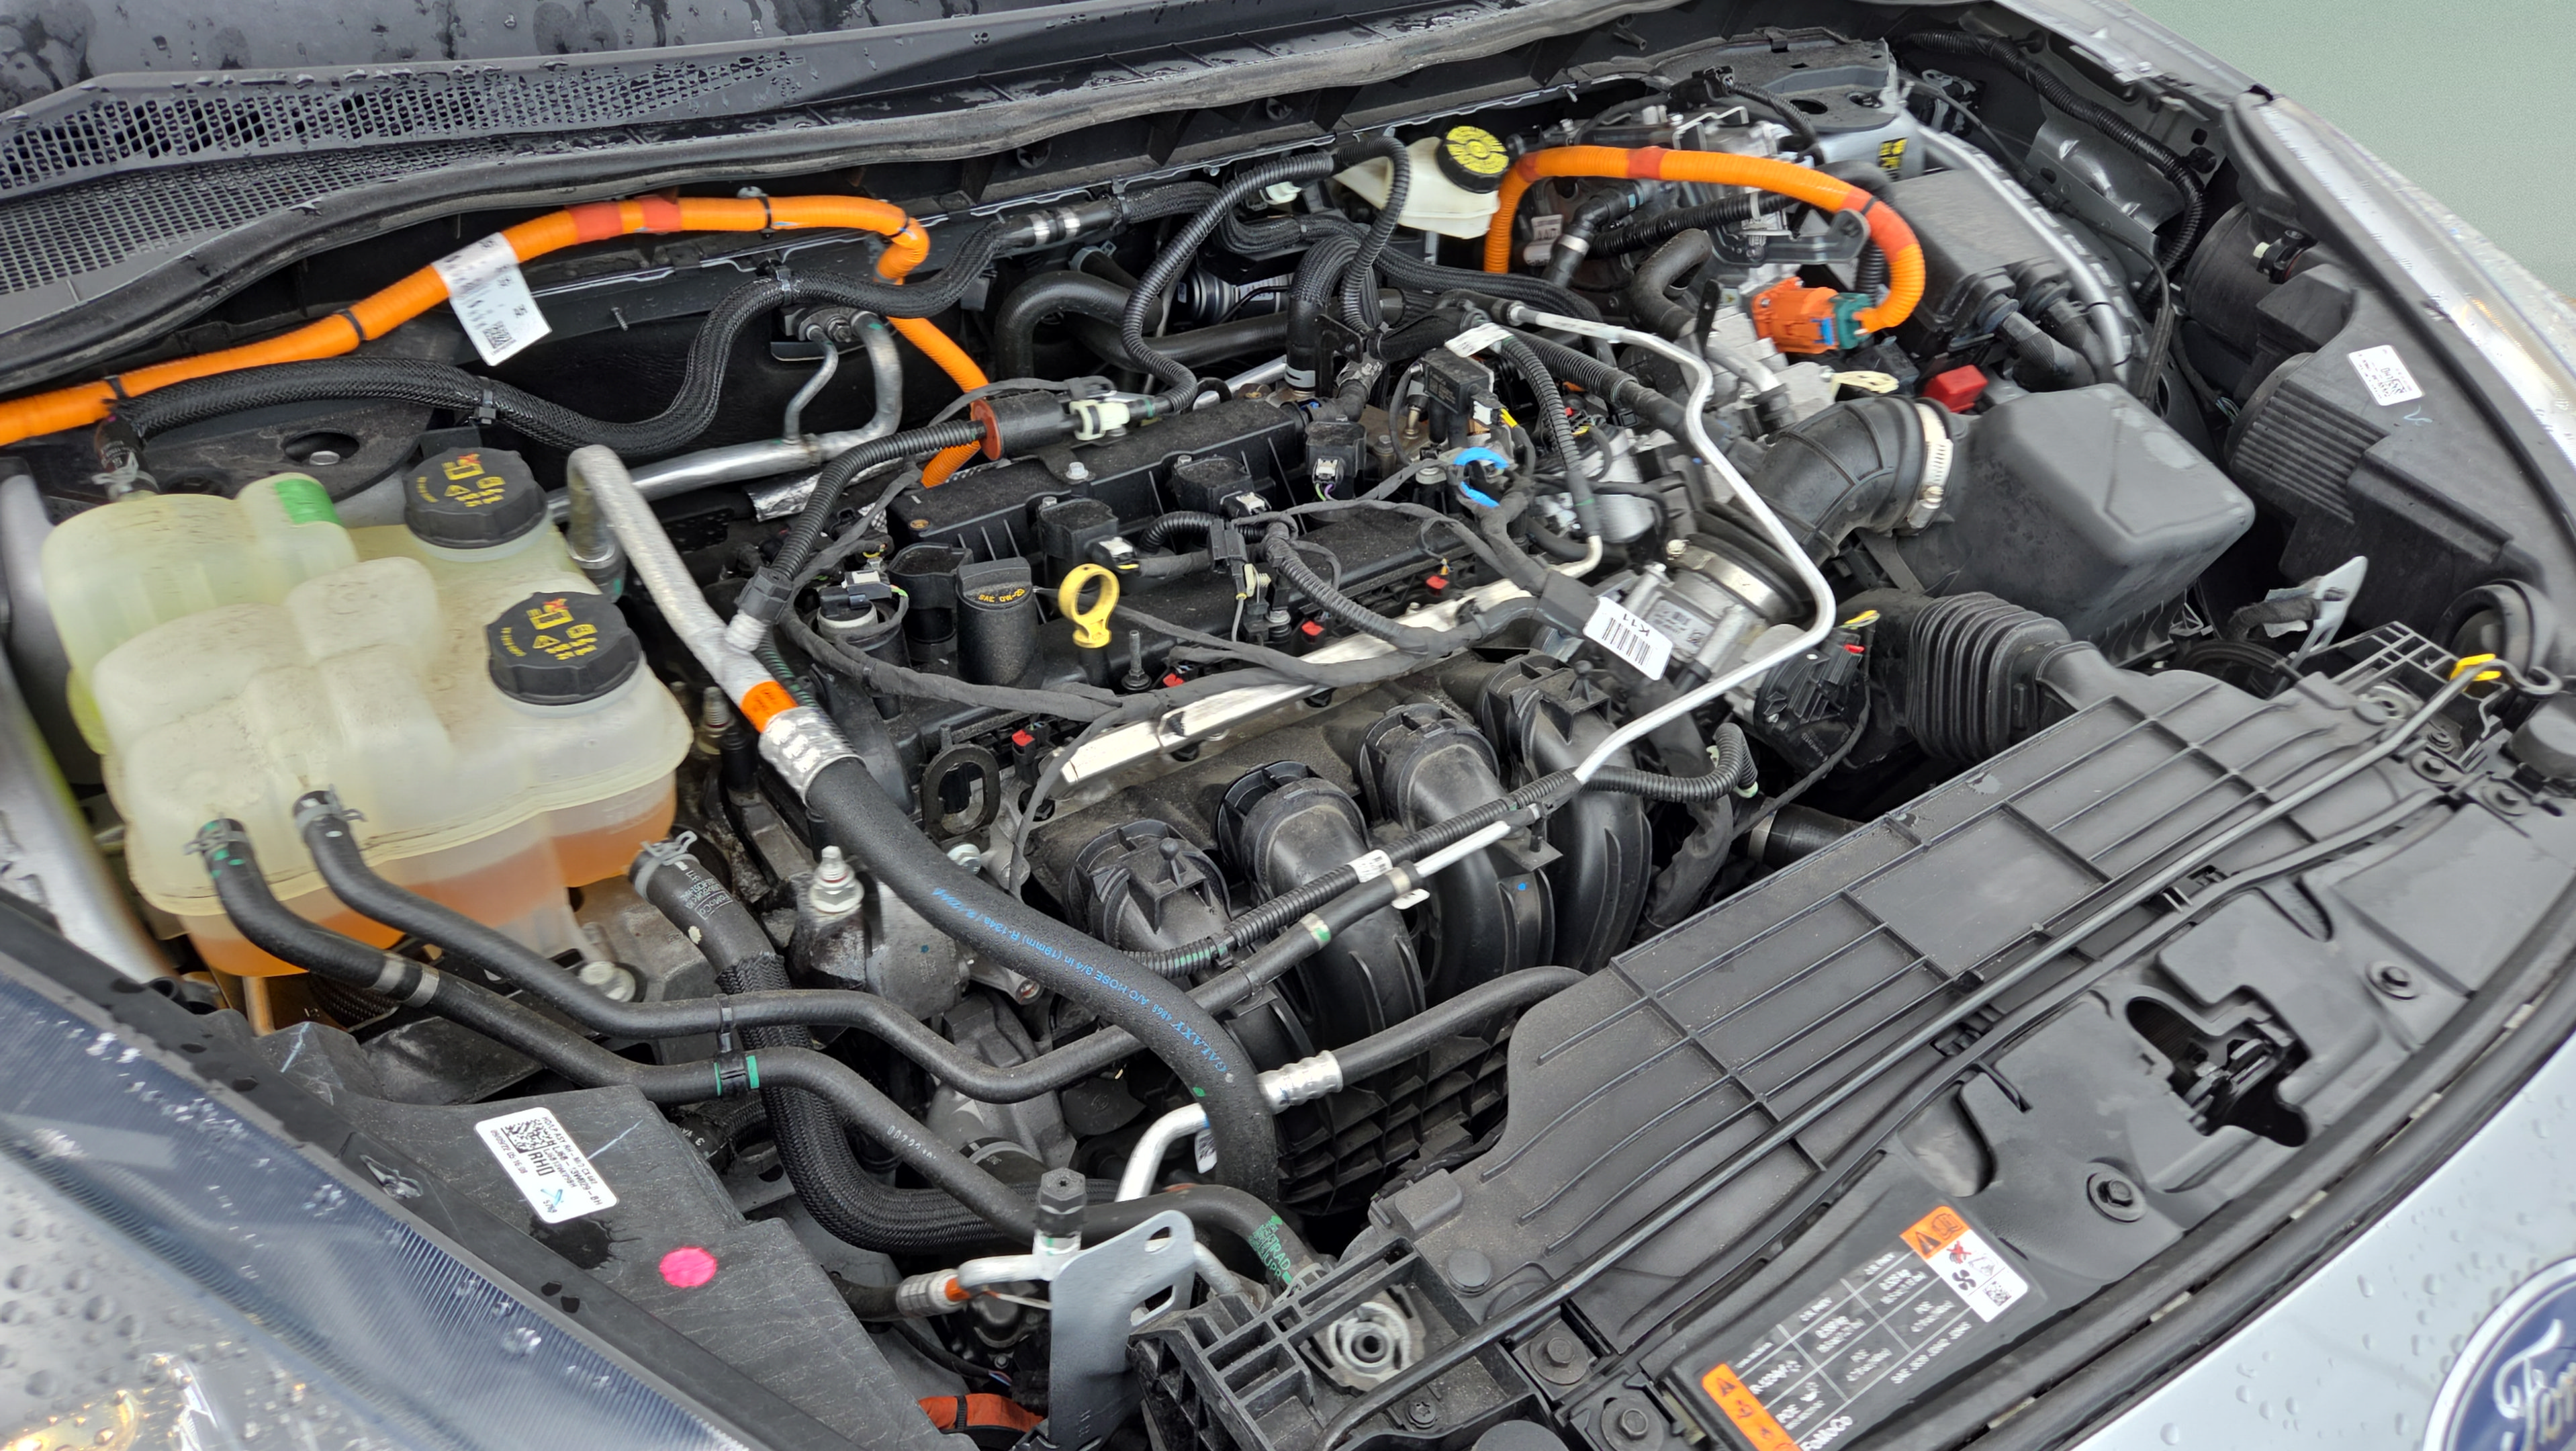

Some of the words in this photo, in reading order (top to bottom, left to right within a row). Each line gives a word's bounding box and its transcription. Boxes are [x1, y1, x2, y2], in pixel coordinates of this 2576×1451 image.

[978, 594, 995, 602] SAE
[1621, 613, 1651, 636] K11
[983, 916, 1021, 940] R-134a
[1021, 934, 1063, 961] (19mm)
[1063, 955, 1074, 966] in
[1075, 960, 1093, 975] 3/4
[1093, 969, 1129, 994] HOSE
[1128, 988, 1149, 1006] A/C
[1150, 1002, 1172, 1020] 4868
[1169, 1020, 1228, 1072] GALAXY
[554, 1133, 566, 1143] ASY
[1270, 1242, 1291, 1270] RAD
[1264, 1258, 1282, 1280] UPR
[1800, 1416, 1853, 1451] FoMoCo
